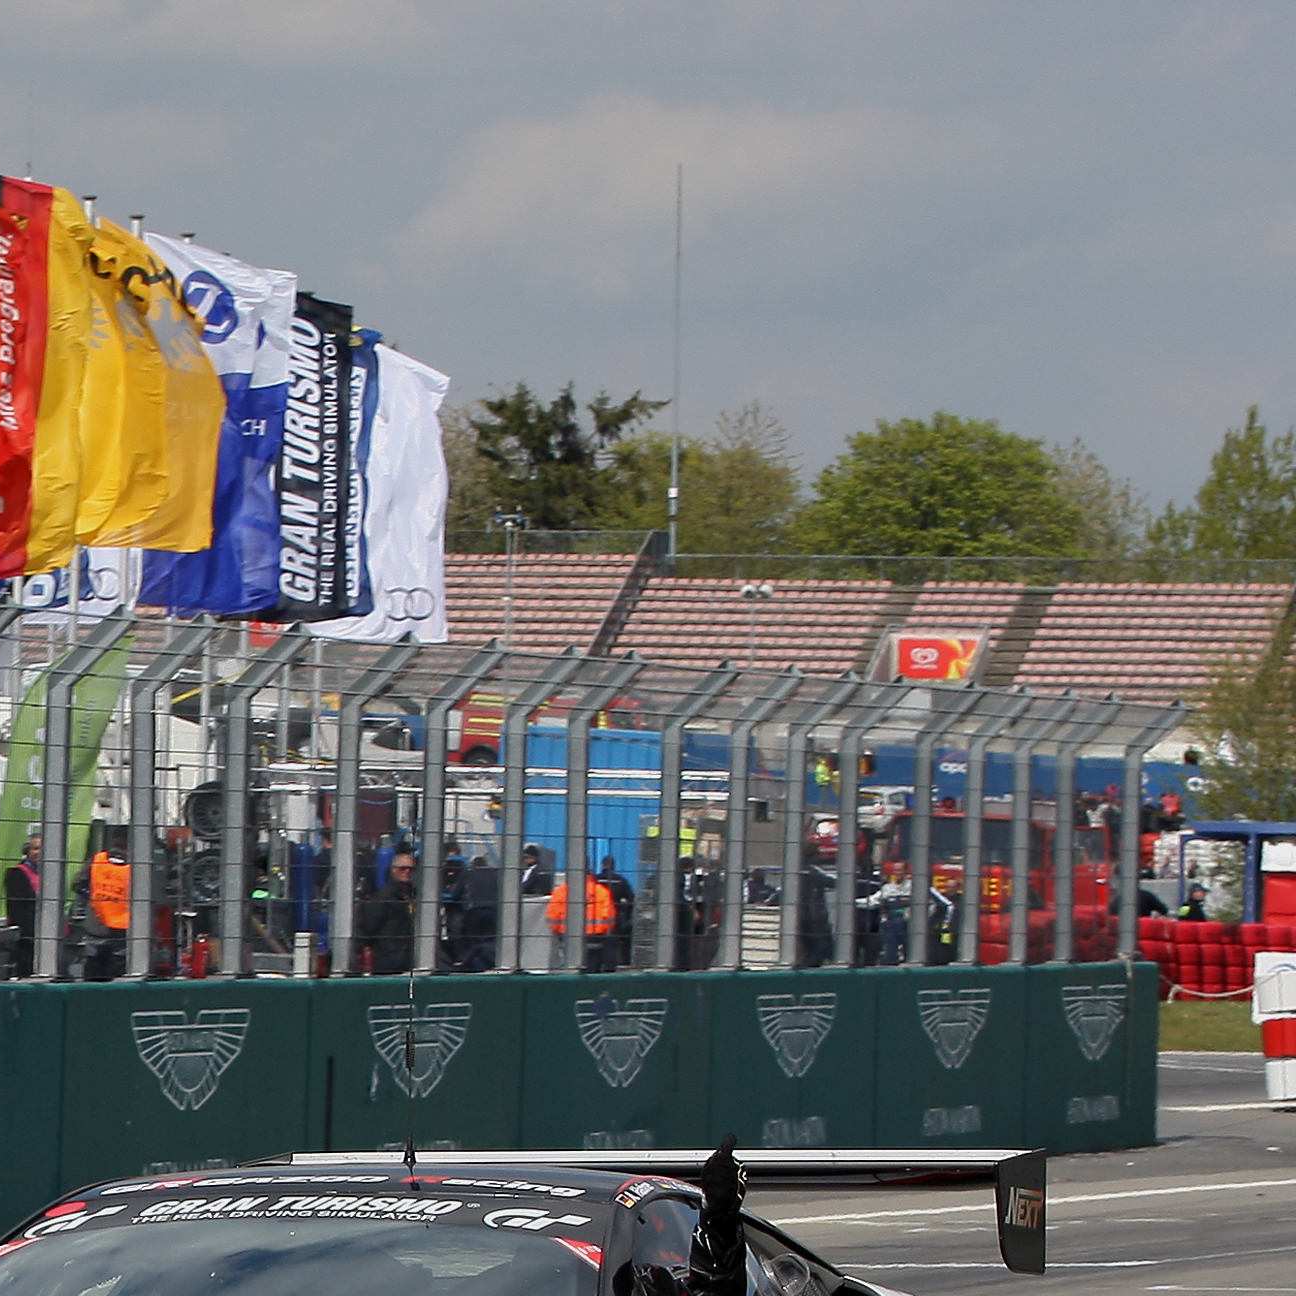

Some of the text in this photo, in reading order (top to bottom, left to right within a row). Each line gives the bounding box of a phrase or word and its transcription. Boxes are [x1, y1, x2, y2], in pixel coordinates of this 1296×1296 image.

[279, 316, 322, 603] GRAN TURISMO
[318, 332, 339, 607] THE REAL DRIVING SIMULATOR
[130, 1208, 438, 1225] THE REAL DRIVING SIMULATOR
[139, 1195, 464, 1217] GRAN TURISMO
[1005, 1186, 1044, 1229] NEXT
